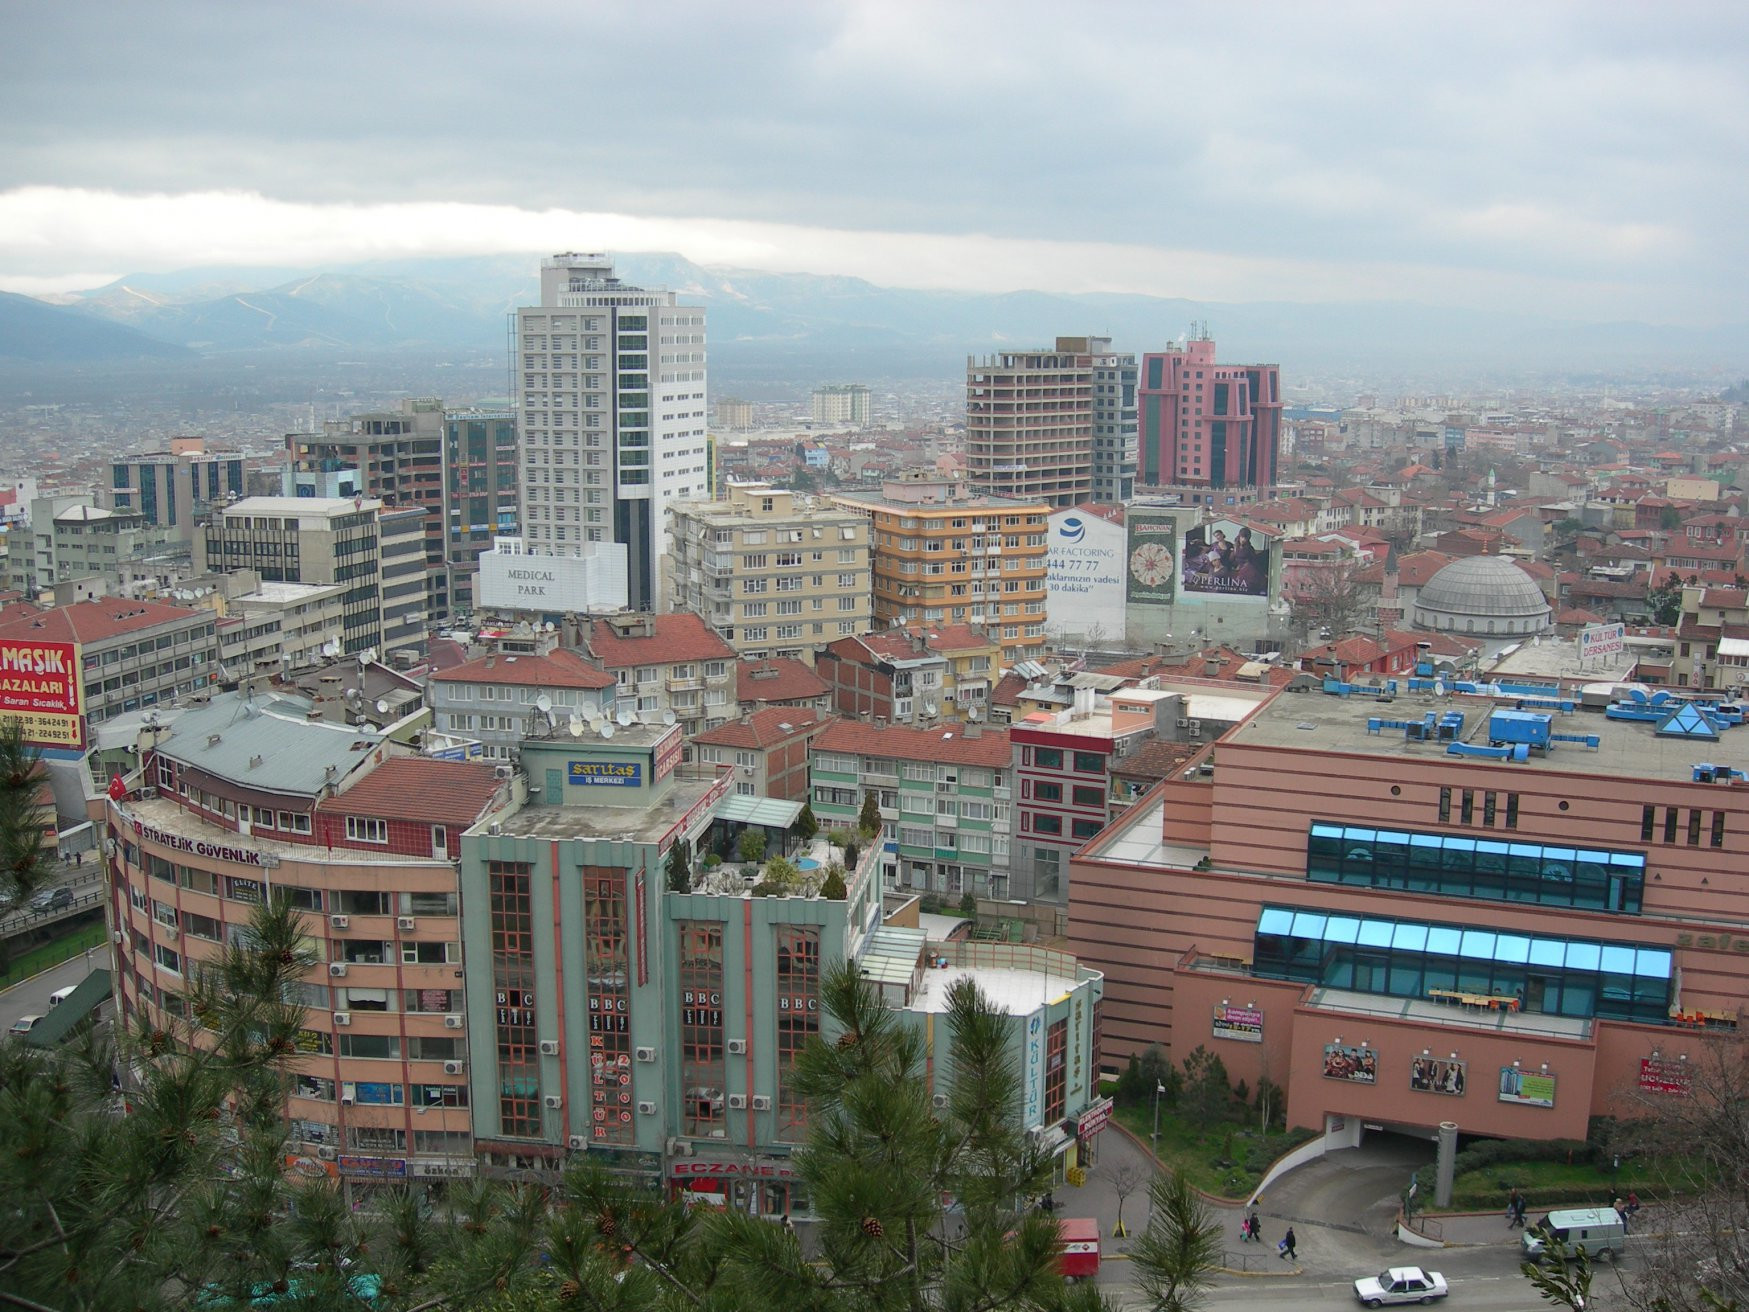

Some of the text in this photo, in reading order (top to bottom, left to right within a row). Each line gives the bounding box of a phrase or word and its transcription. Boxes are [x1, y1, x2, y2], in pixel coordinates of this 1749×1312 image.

[1062, 548, 1114, 558] FACTORING
[1069, 560, 1082, 570] 77
[1086, 561, 1099, 571] 77
[508, 569, 555, 581] MEDICAL
[1094, 576, 1120, 584] vadesi
[518, 585, 546, 595] PARK
[1049, 583, 1060, 592] 30
[0, 647, 65, 675] MAŞIK
[0, 679, 63, 694] AZALARI
[4, 696, 29, 706] Saran
[591, 998, 627, 1011] BBC
[685, 992, 720, 1005] BBC
[781, 998, 817, 1010] BBC
[1029, 1041, 1039, 1118] KÜLTÜR
[674, 1163, 774, 1176] ECZANE
